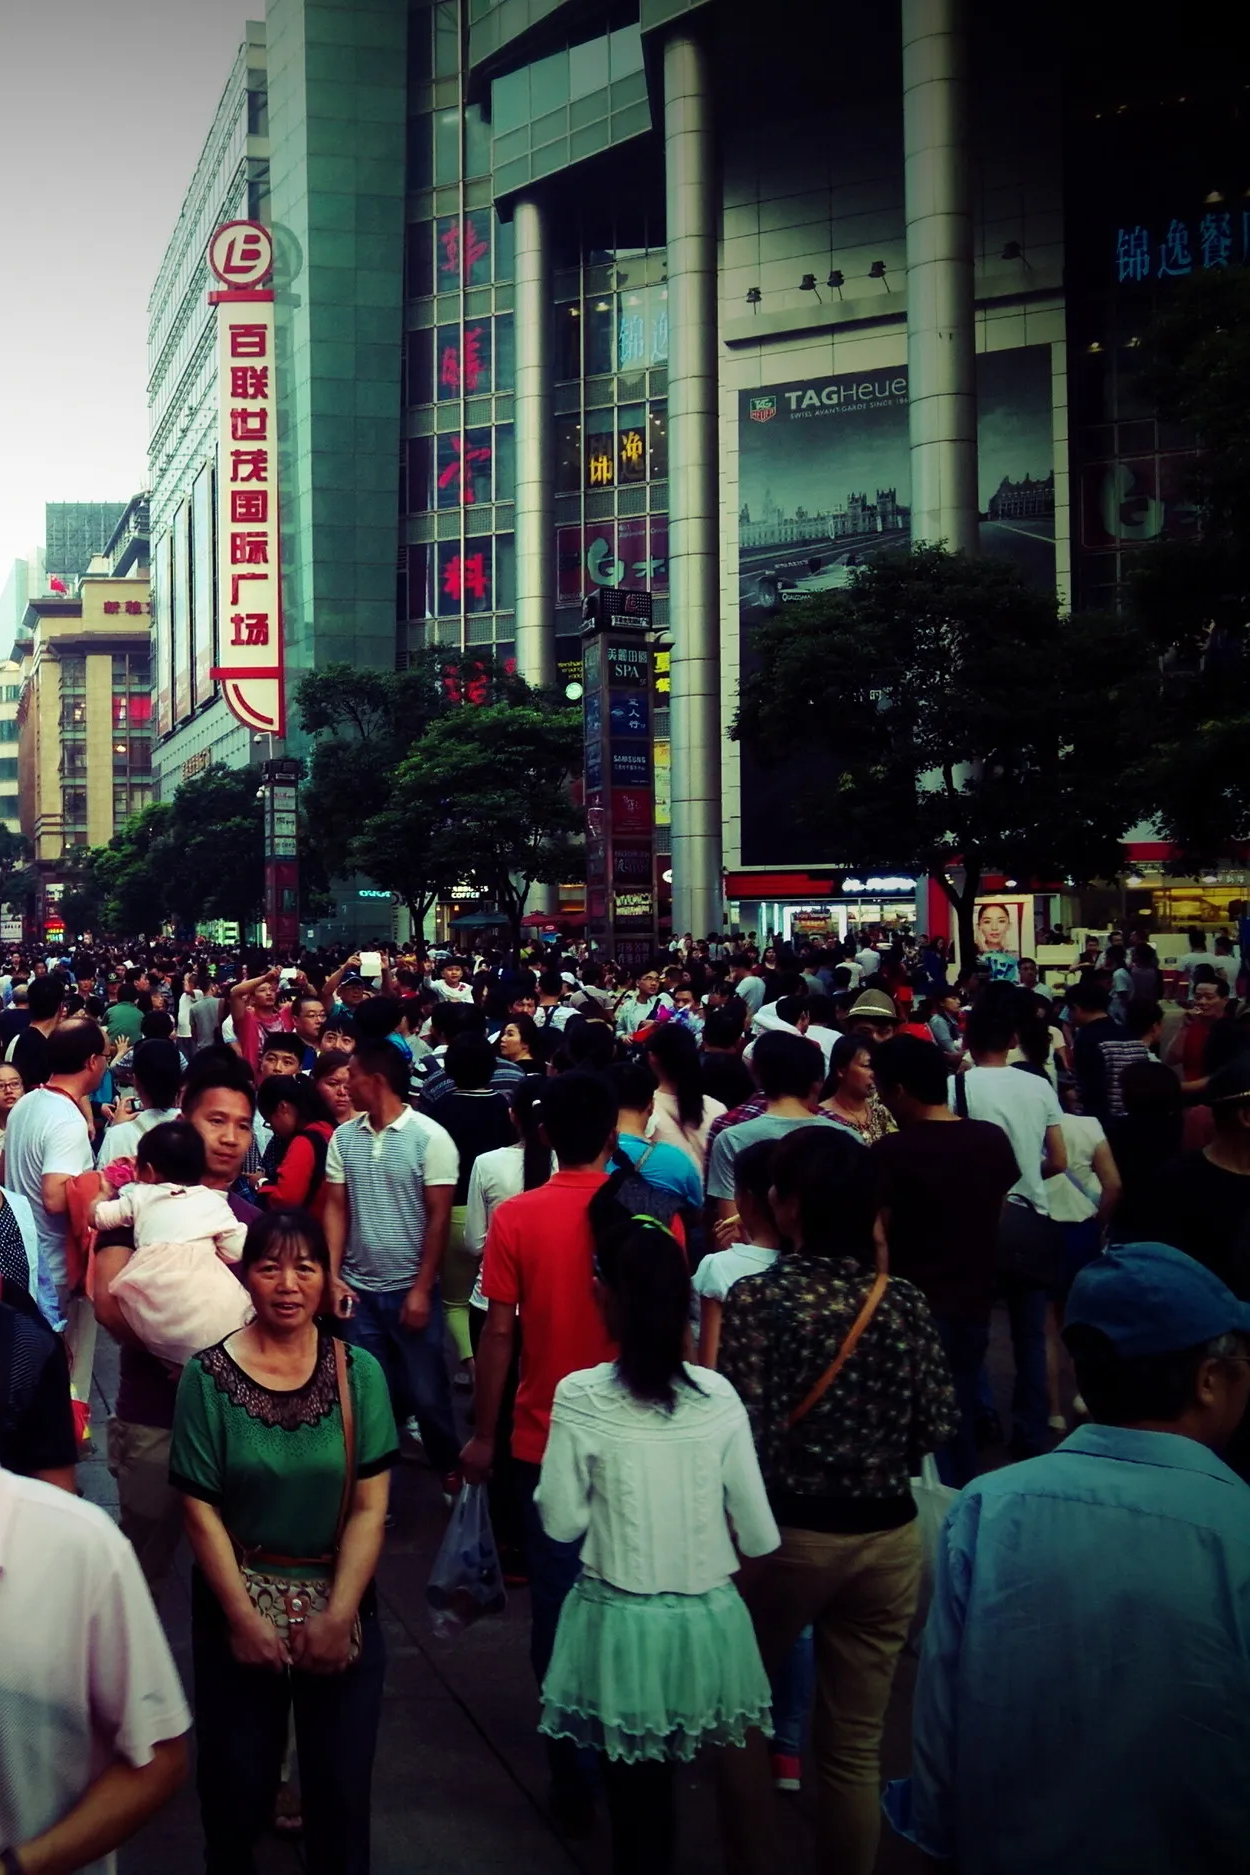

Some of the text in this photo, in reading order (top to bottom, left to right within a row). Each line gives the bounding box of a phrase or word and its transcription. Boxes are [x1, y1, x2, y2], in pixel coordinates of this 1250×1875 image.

[1115, 210, 1250, 284] 锦逸餐
[784, 377, 908, 411] TAGHeue
[229, 323, 269, 648] 百联世茂国际广场
[614, 665, 640, 679] SPA
[613, 755, 647, 764] SAMSUNG
